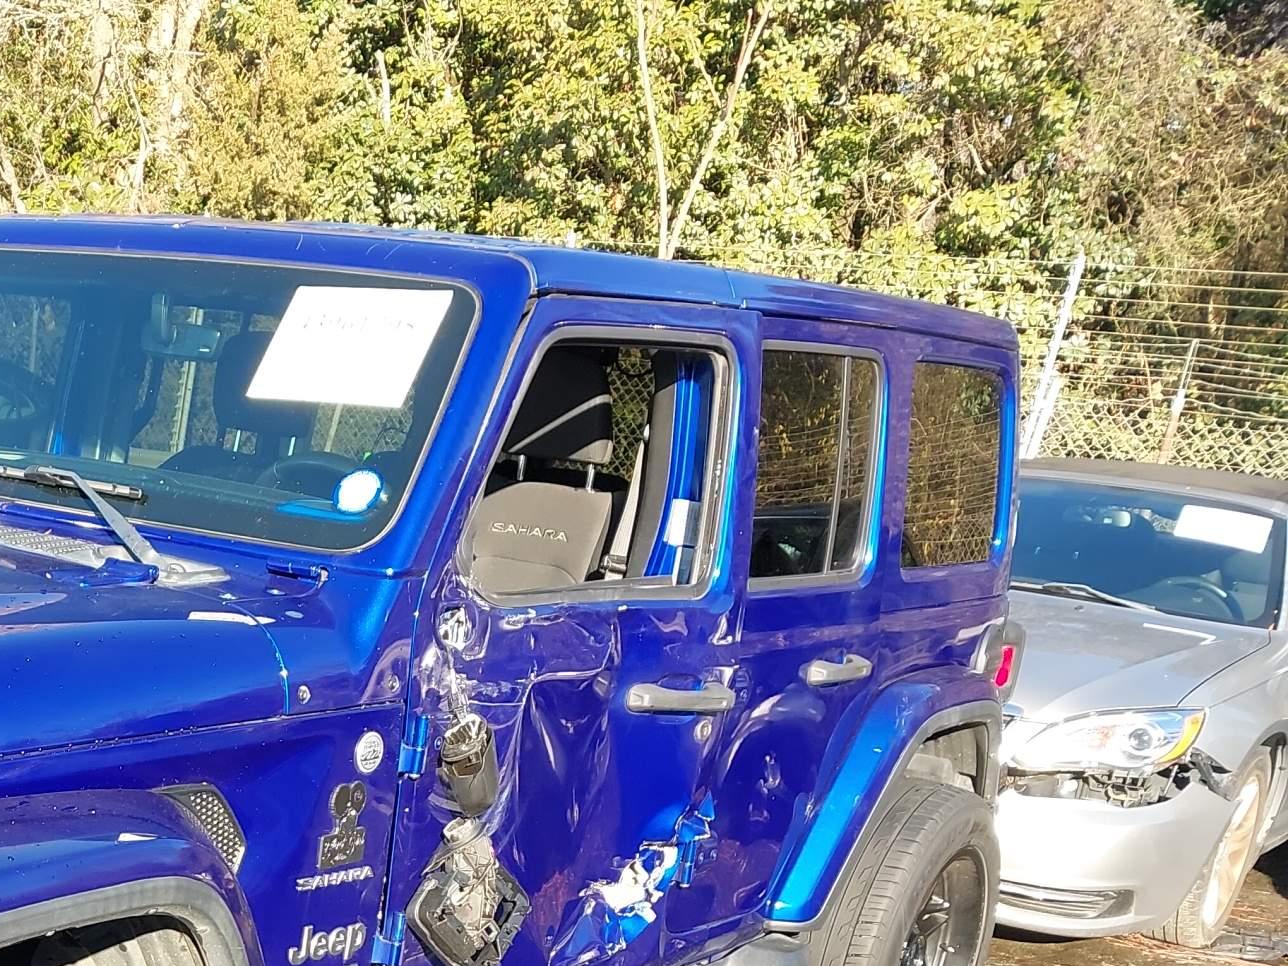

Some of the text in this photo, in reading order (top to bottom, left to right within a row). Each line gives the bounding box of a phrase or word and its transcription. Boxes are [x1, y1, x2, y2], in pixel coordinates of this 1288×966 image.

[491, 522, 568, 542] SAHARA
[296, 866, 374, 891] SAHARA
[288, 922, 367, 966] Jeep
